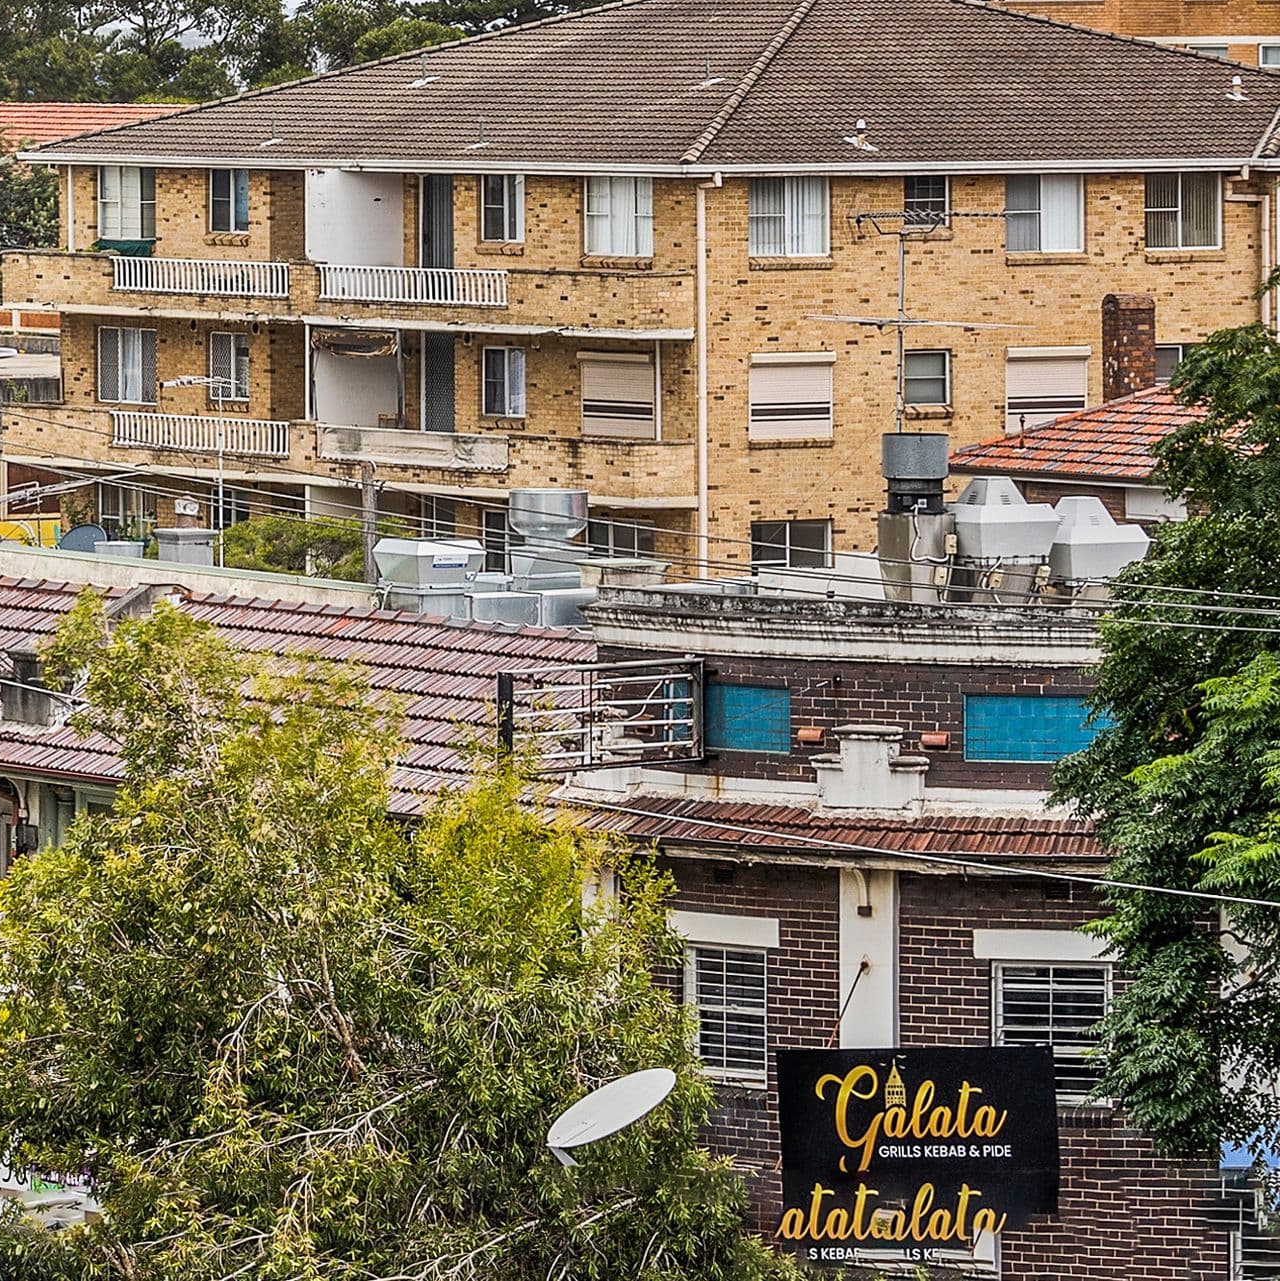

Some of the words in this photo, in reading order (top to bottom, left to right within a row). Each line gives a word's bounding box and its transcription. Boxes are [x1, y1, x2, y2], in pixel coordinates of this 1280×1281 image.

[815, 1064, 1008, 1173] Galata
[878, 1144, 922, 1159] GRILLS
[923, 1145, 967, 1158] KEBAB
[968, 1145, 981, 1158] &
[982, 1145, 1012, 1158] PIDE
